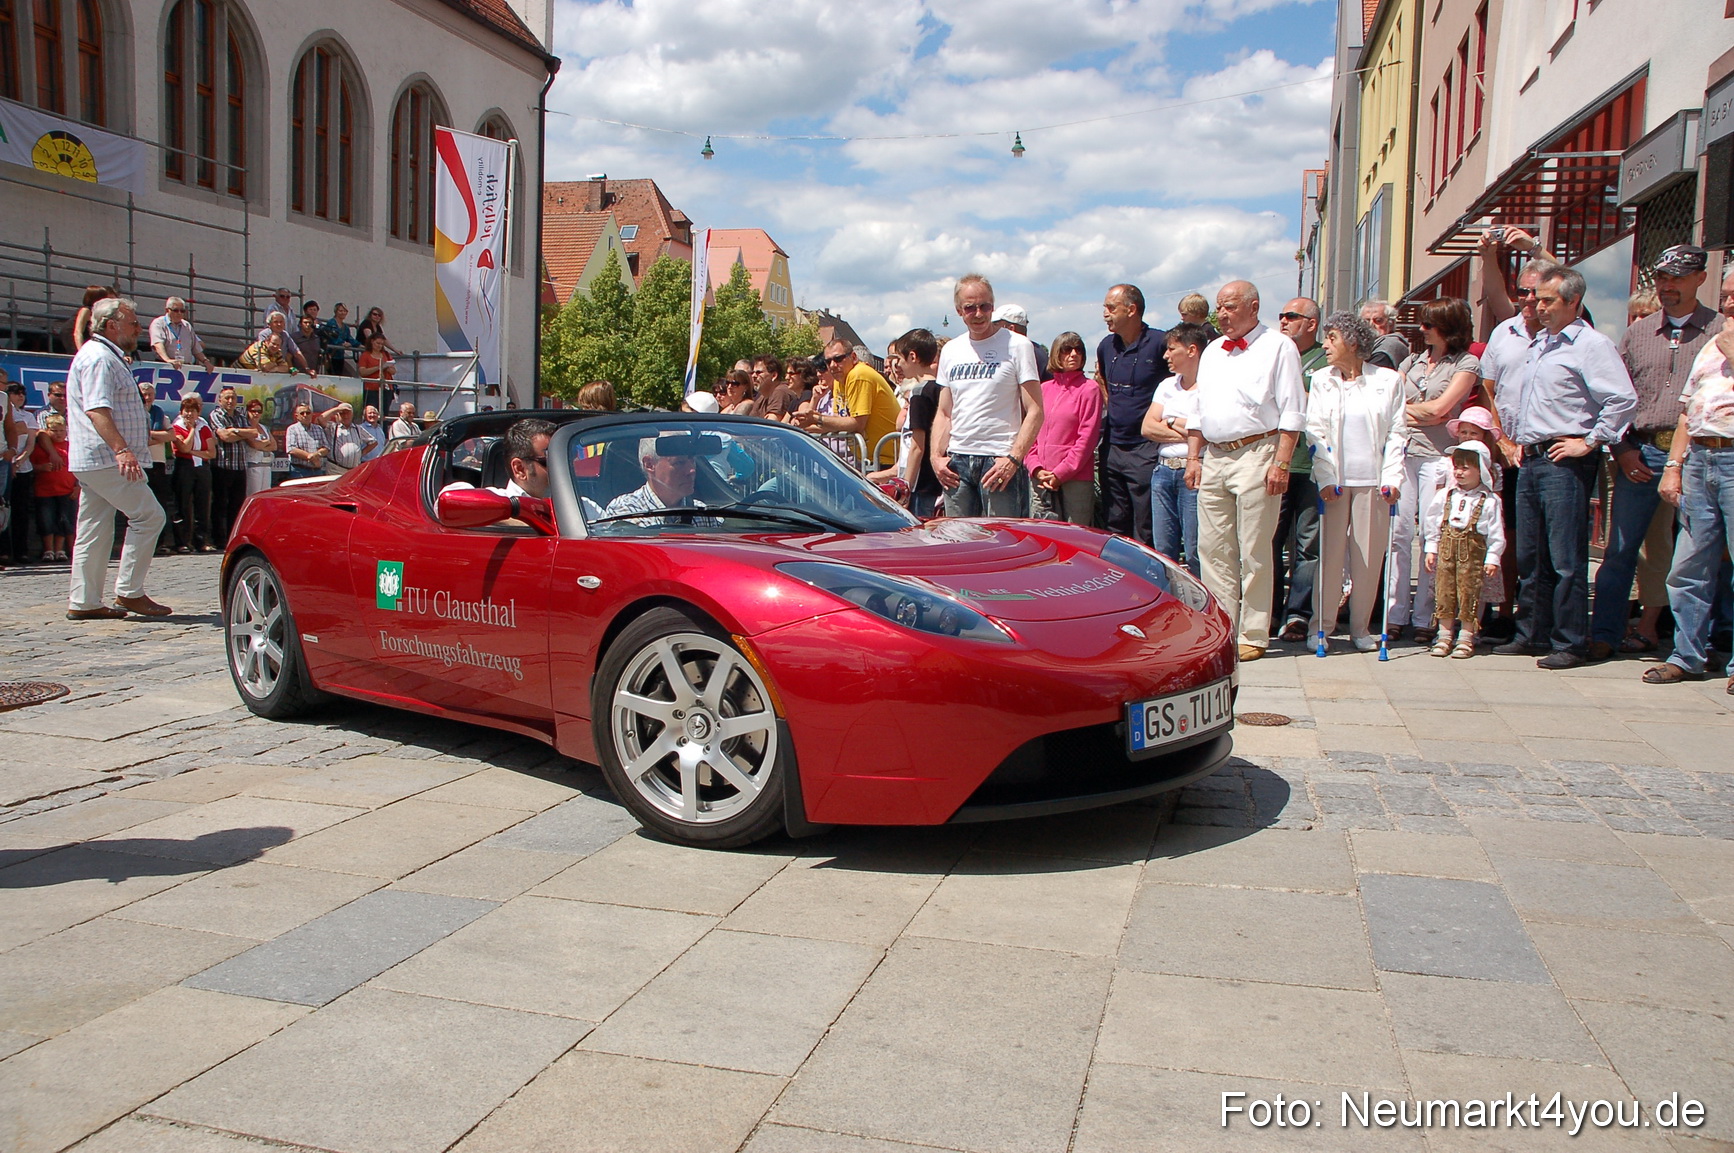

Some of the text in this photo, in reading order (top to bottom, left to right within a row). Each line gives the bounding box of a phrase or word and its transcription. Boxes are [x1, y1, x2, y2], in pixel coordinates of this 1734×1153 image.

[62, 140, 71, 152] 12
[404, 586, 517, 628] TU Clausthal
[379, 630, 524, 681] Forschungsfahrzeug
[1145, 684, 1230, 740] GS TU 10
[1134, 731, 1141, 742] D
